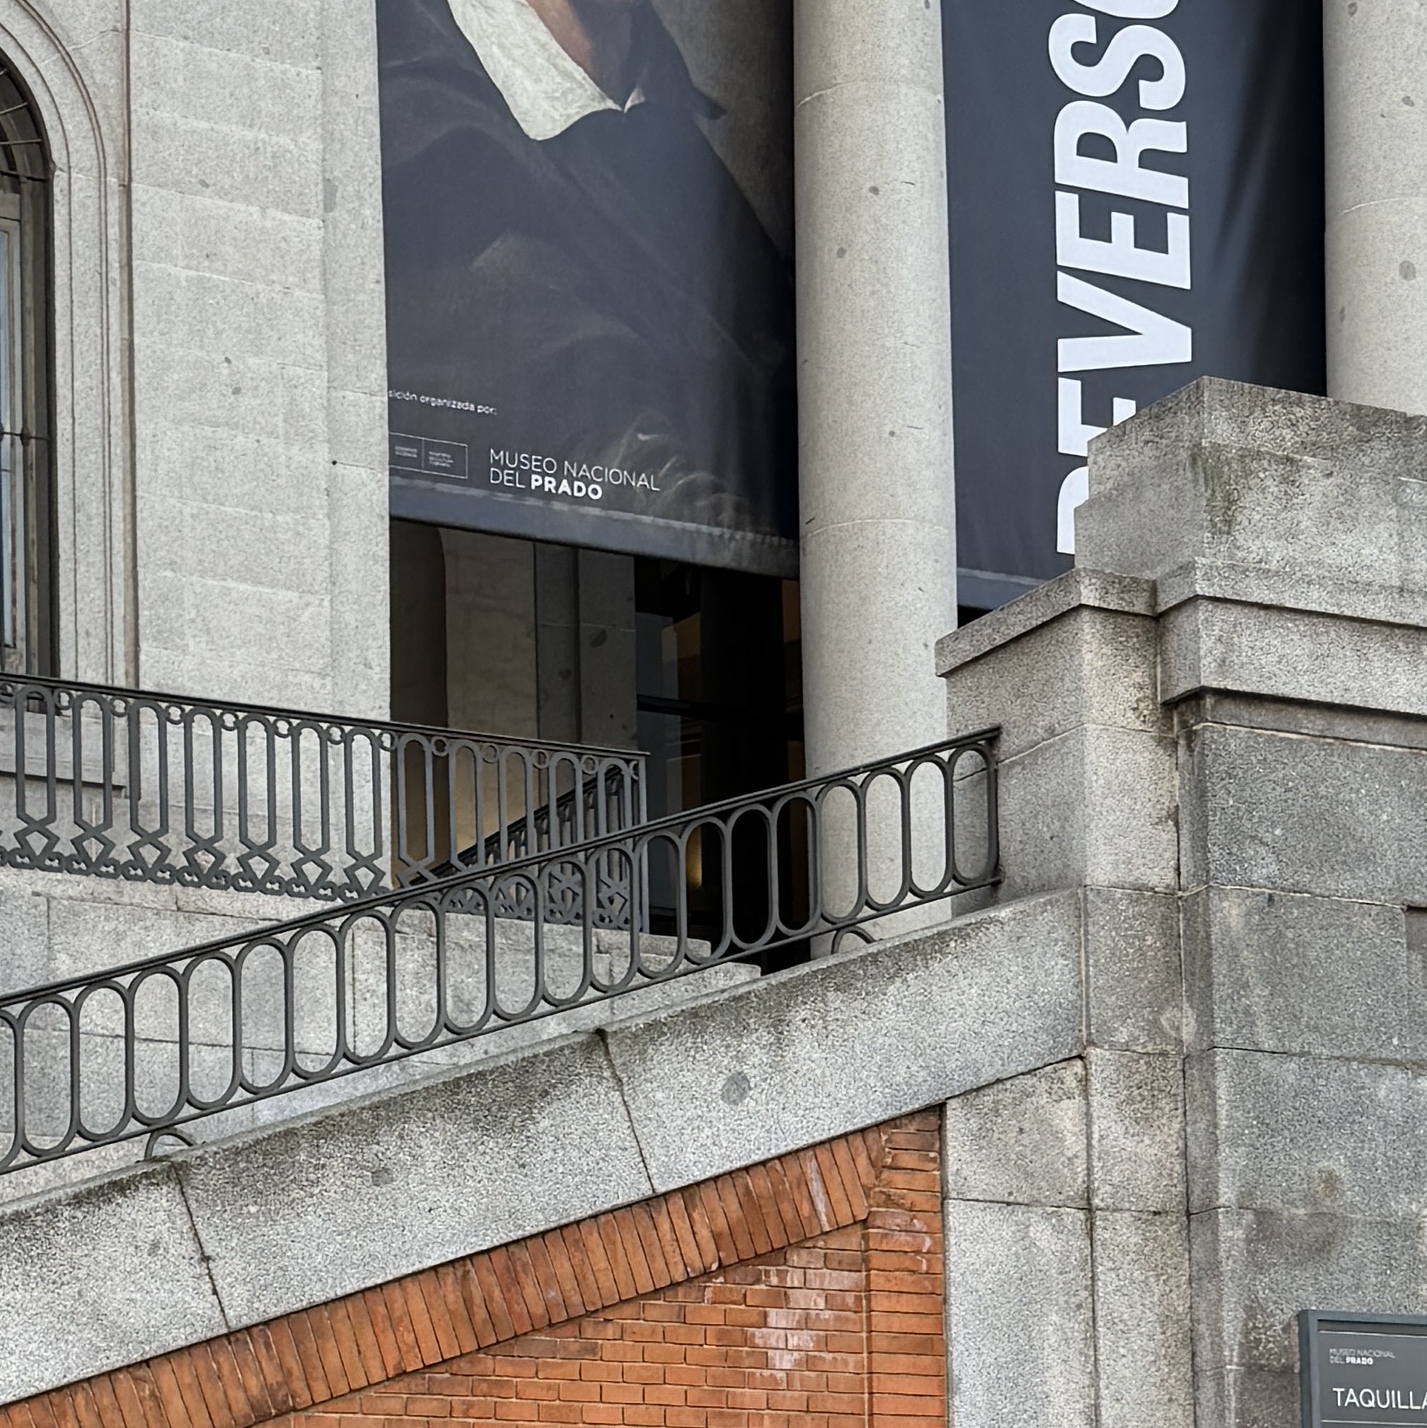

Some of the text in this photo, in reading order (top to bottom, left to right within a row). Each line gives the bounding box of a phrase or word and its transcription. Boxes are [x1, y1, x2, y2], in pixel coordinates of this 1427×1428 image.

[419, 395, 476, 412] organizada
[490, 449, 661, 492] MUSEO NACIONAL
[490, 468, 603, 500] DEL PRADO
